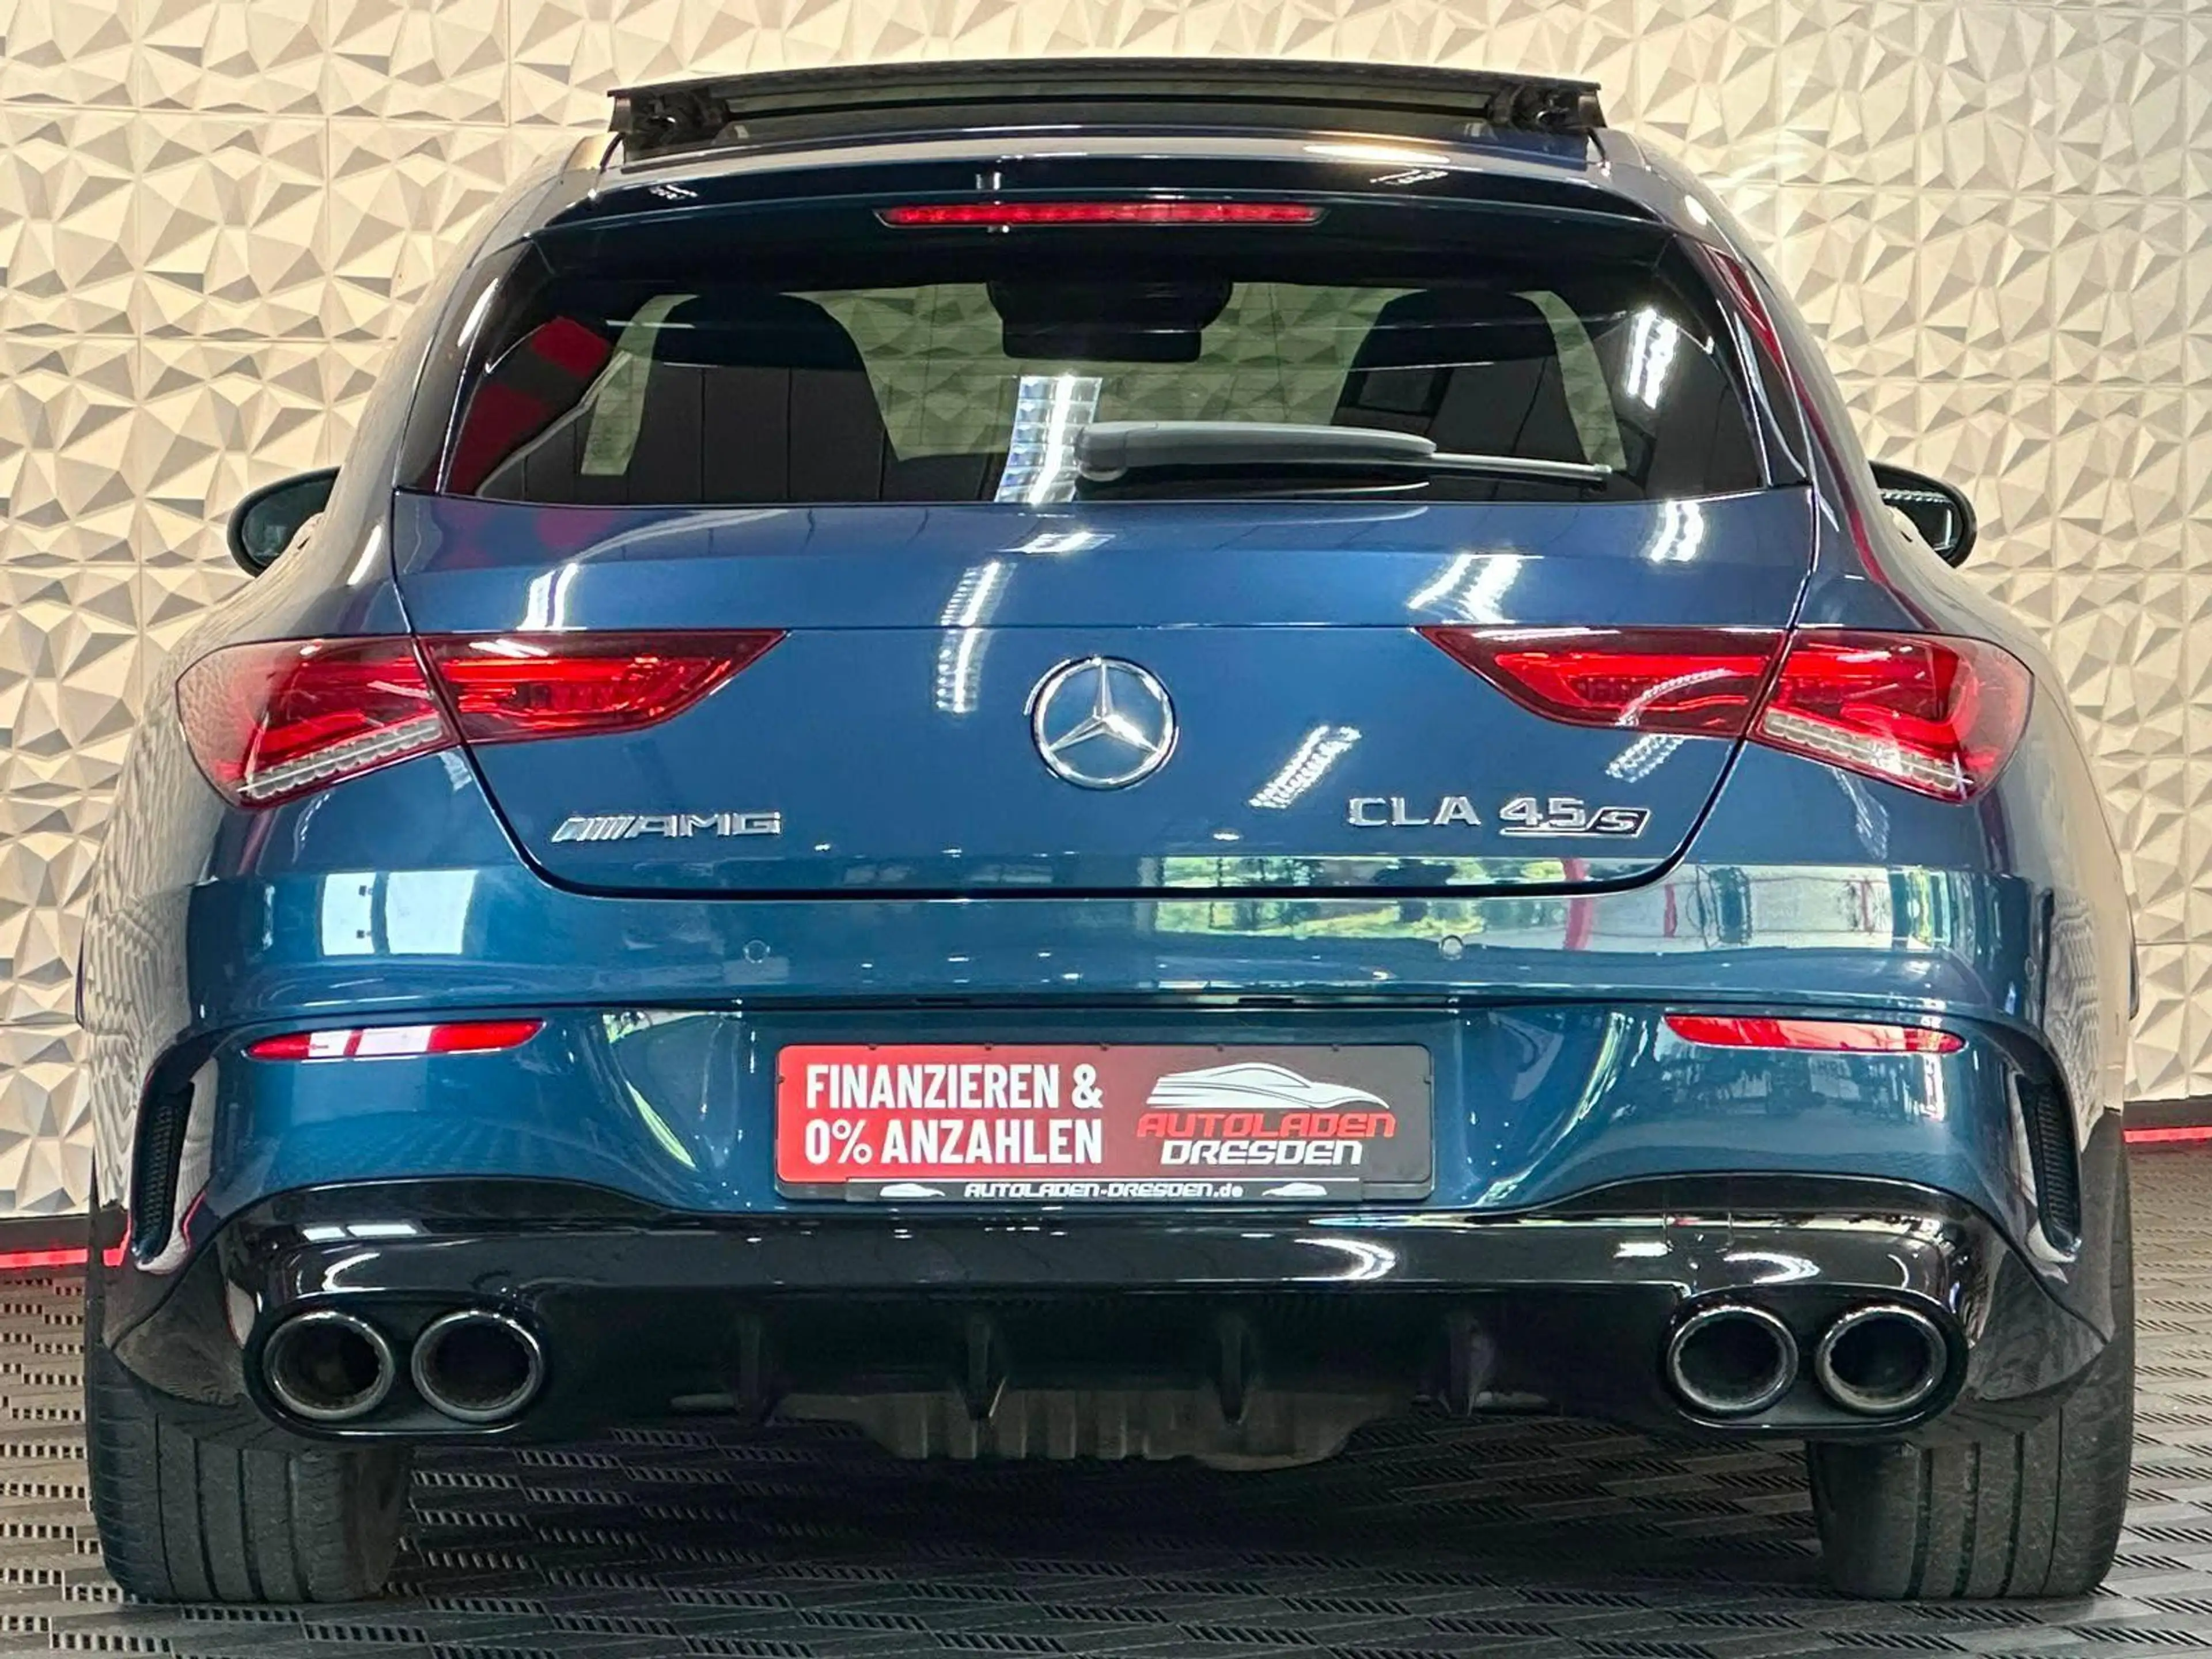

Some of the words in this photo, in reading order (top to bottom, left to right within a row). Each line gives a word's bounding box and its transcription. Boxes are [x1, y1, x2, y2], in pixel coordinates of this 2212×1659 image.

[1347, 796, 1482, 827] CLA
[625, 812, 781, 838] AMG
[806, 1064, 1059, 1109] FINANZIEREN
[1071, 1063, 1104, 1109] &
[1137, 1112, 1396, 1138] AUTOLADEN
[805, 1118, 873, 1164] 0%
[880, 1118, 1103, 1164] ANZAHLEN
[1160, 1139, 1363, 1165] DRESDEN
[964, 1182, 1244, 1198] AUTOLADEN-DRESDEN.de
